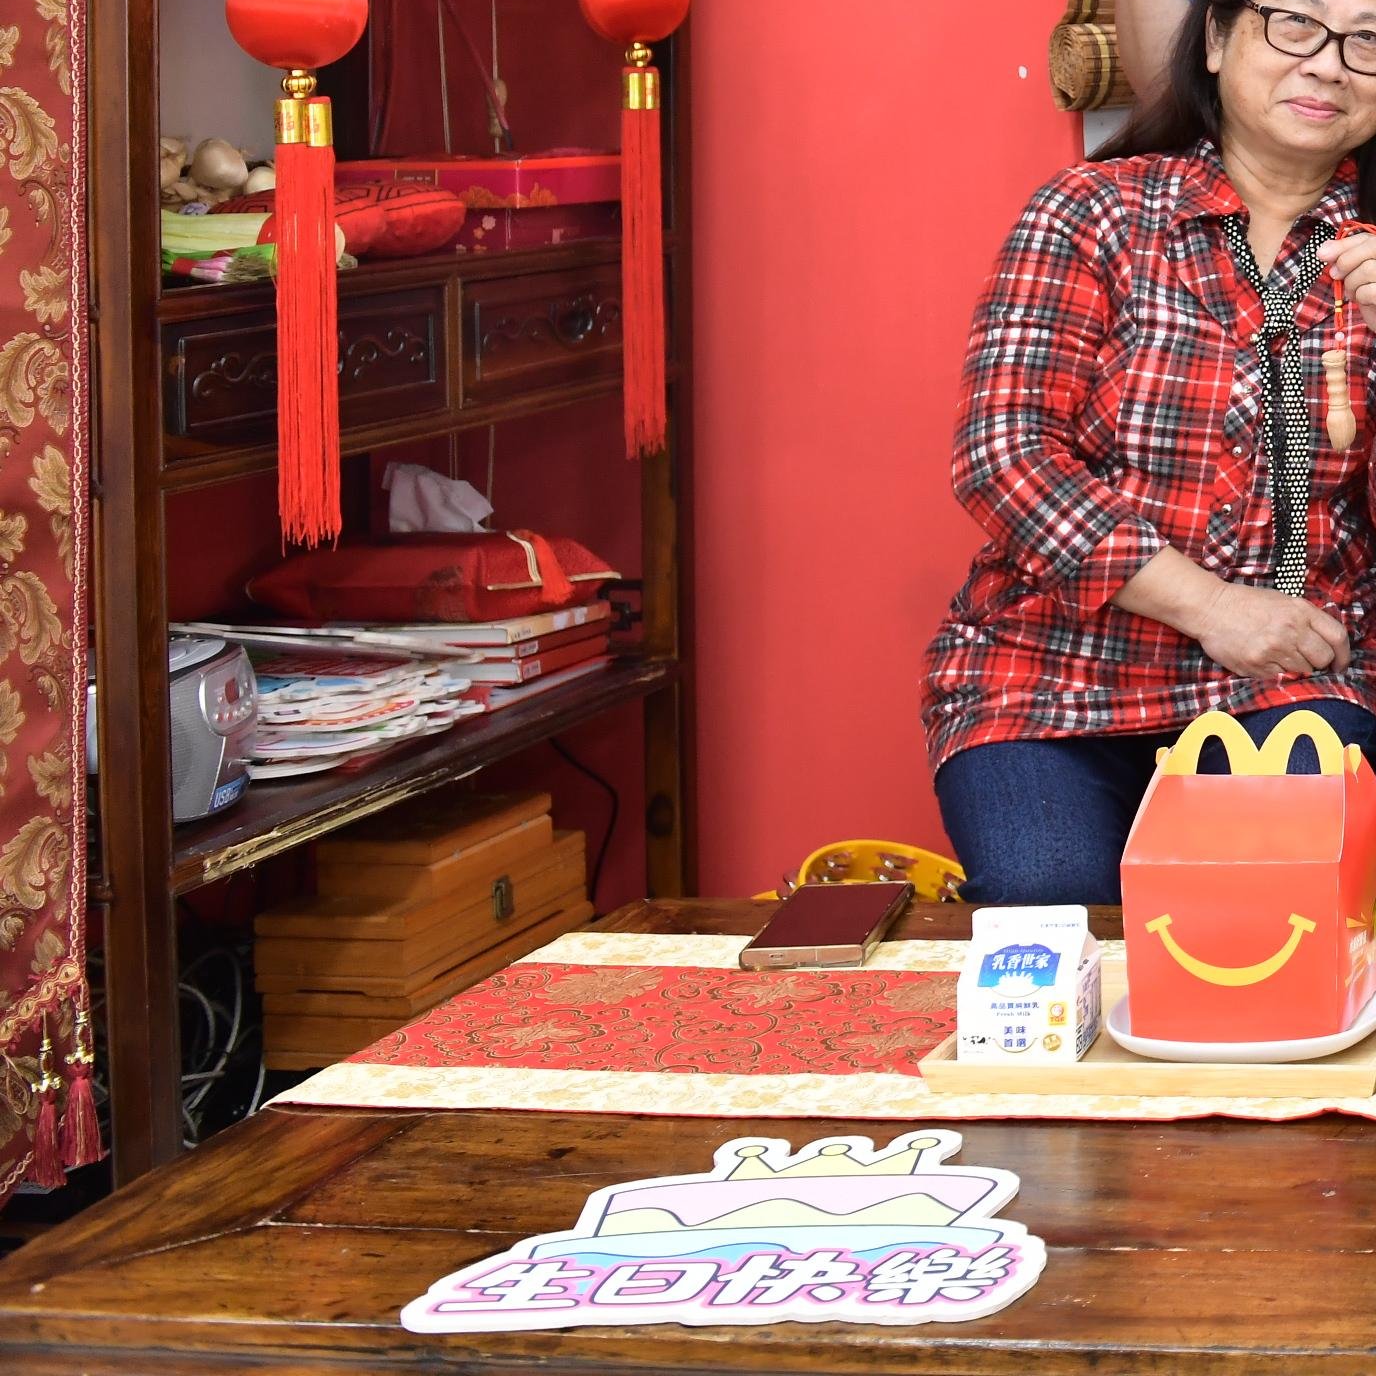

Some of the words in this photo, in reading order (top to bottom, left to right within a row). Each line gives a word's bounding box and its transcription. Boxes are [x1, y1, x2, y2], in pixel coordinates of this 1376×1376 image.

[991, 953, 1052, 970] 乳香世家
[1004, 1026, 1027, 1035] 美味
[436, 1246, 1014, 1312] 生日快樂
